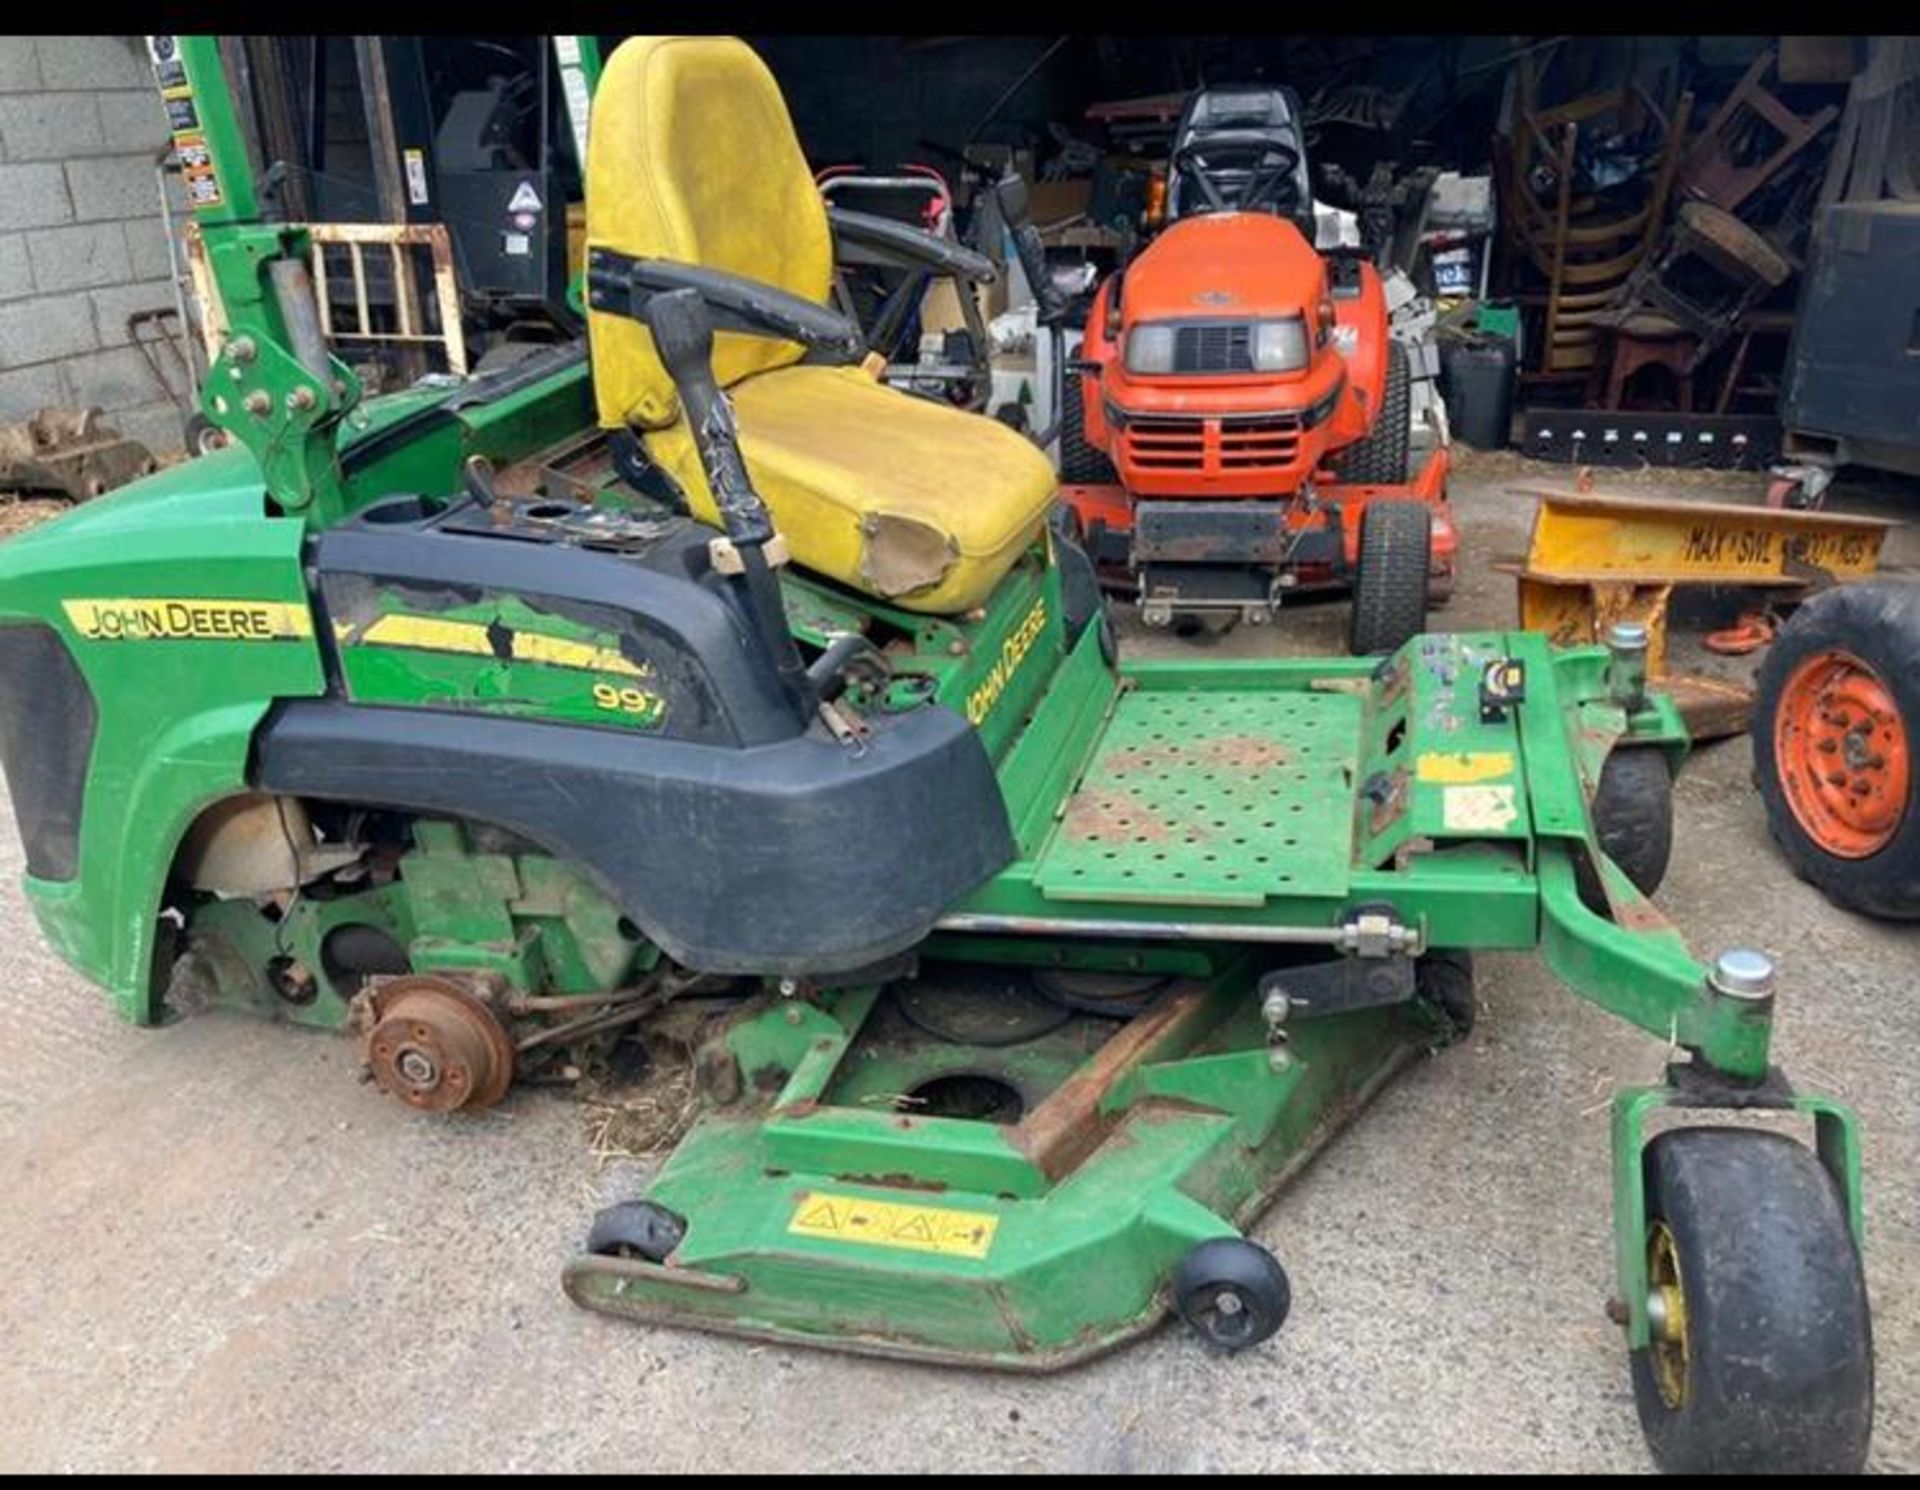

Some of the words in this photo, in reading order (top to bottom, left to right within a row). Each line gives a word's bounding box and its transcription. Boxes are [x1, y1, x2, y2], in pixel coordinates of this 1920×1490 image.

[1683, 526, 1724, 563] MAX
[1736, 529, 1773, 565] SWL
[88, 605, 163, 635] JOHN
[166, 603, 271, 634] DEERE
[966, 659, 1005, 725] JOHN
[1003, 598, 1045, 680] DEERE
